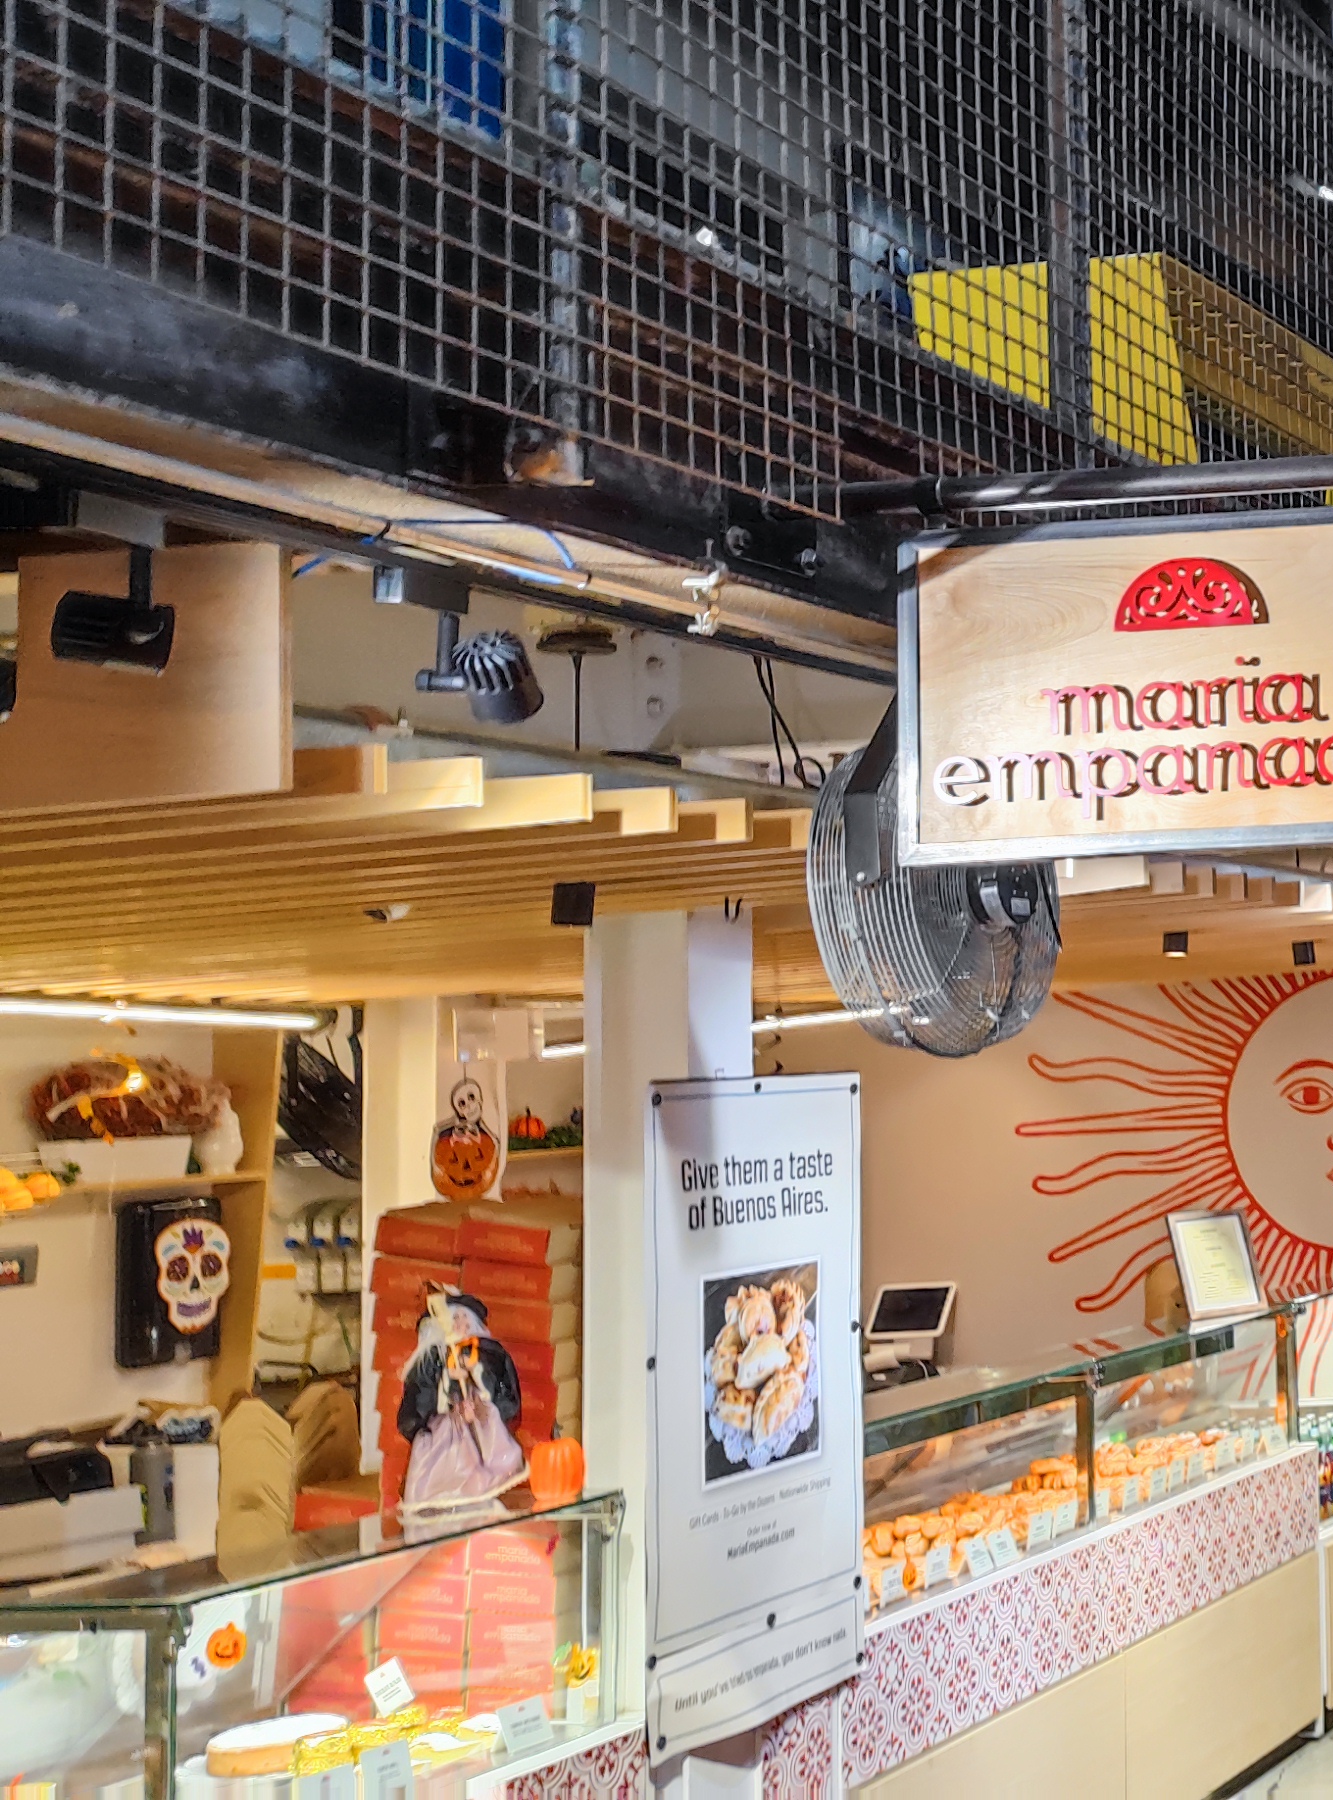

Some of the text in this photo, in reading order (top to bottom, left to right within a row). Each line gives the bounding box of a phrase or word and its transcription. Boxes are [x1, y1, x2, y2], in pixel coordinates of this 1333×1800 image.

[1040, 655, 1327, 736] maria
[681, 1148, 834, 1193] Give them a taste
[688, 1186, 829, 1231] of Buenos Aires.
[485, 1552, 541, 1566] empanada
[497, 1545, 529, 1557] maria
[675, 1690, 699, 1712] Until
[700, 1681, 730, 1704] you've
[781, 1650, 794, 1668] you
[795, 1642, 813, 1660] don't
[814, 1637, 832, 1652] know
